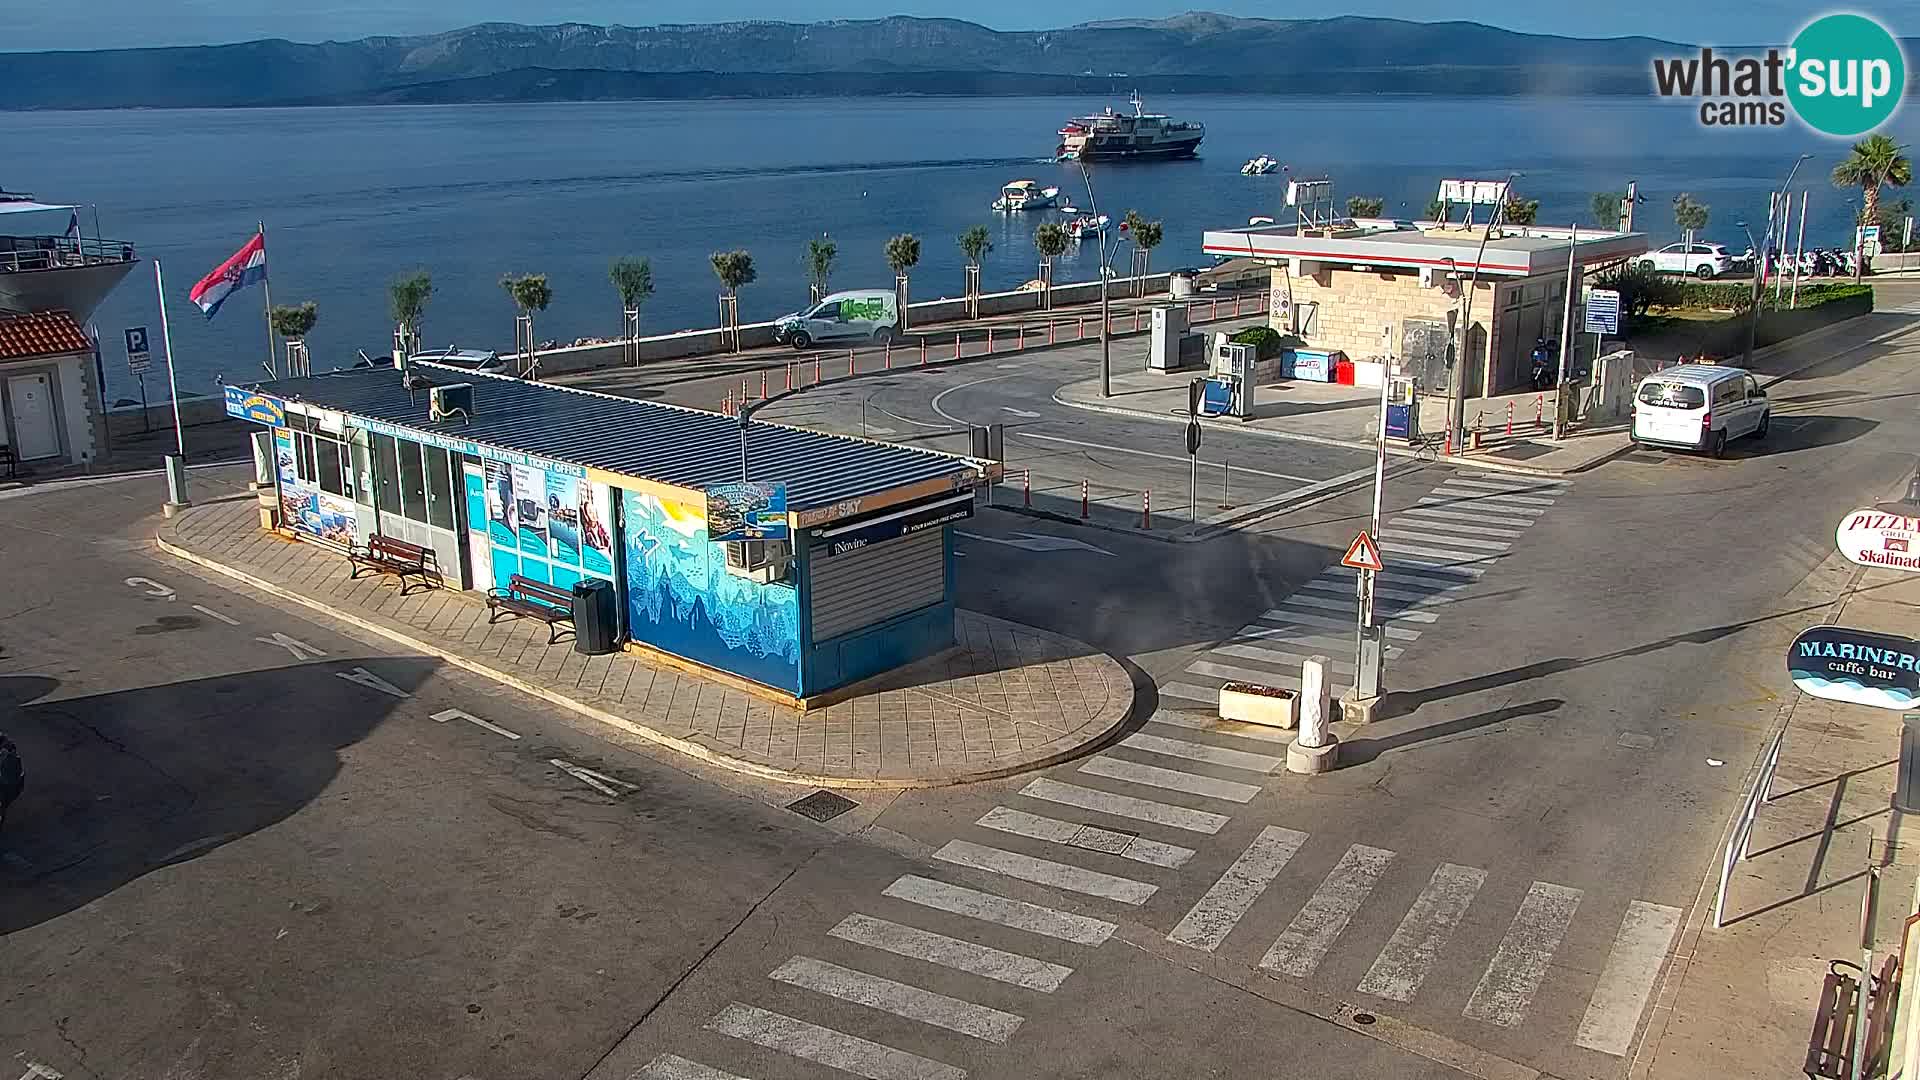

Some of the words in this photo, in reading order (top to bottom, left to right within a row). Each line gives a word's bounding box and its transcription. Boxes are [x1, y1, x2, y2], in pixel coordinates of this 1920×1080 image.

[130, 331, 142, 350] P
[478, 445, 493, 458] BUS
[493, 449, 526, 464] STATION
[527, 456, 554, 471] TICKET
[554, 462, 582, 477] OFFICE
[1848, 515, 1920, 532] PIZZE
[1828, 661, 1865, 675] caffe
[1869, 665, 1896, 680] bar
